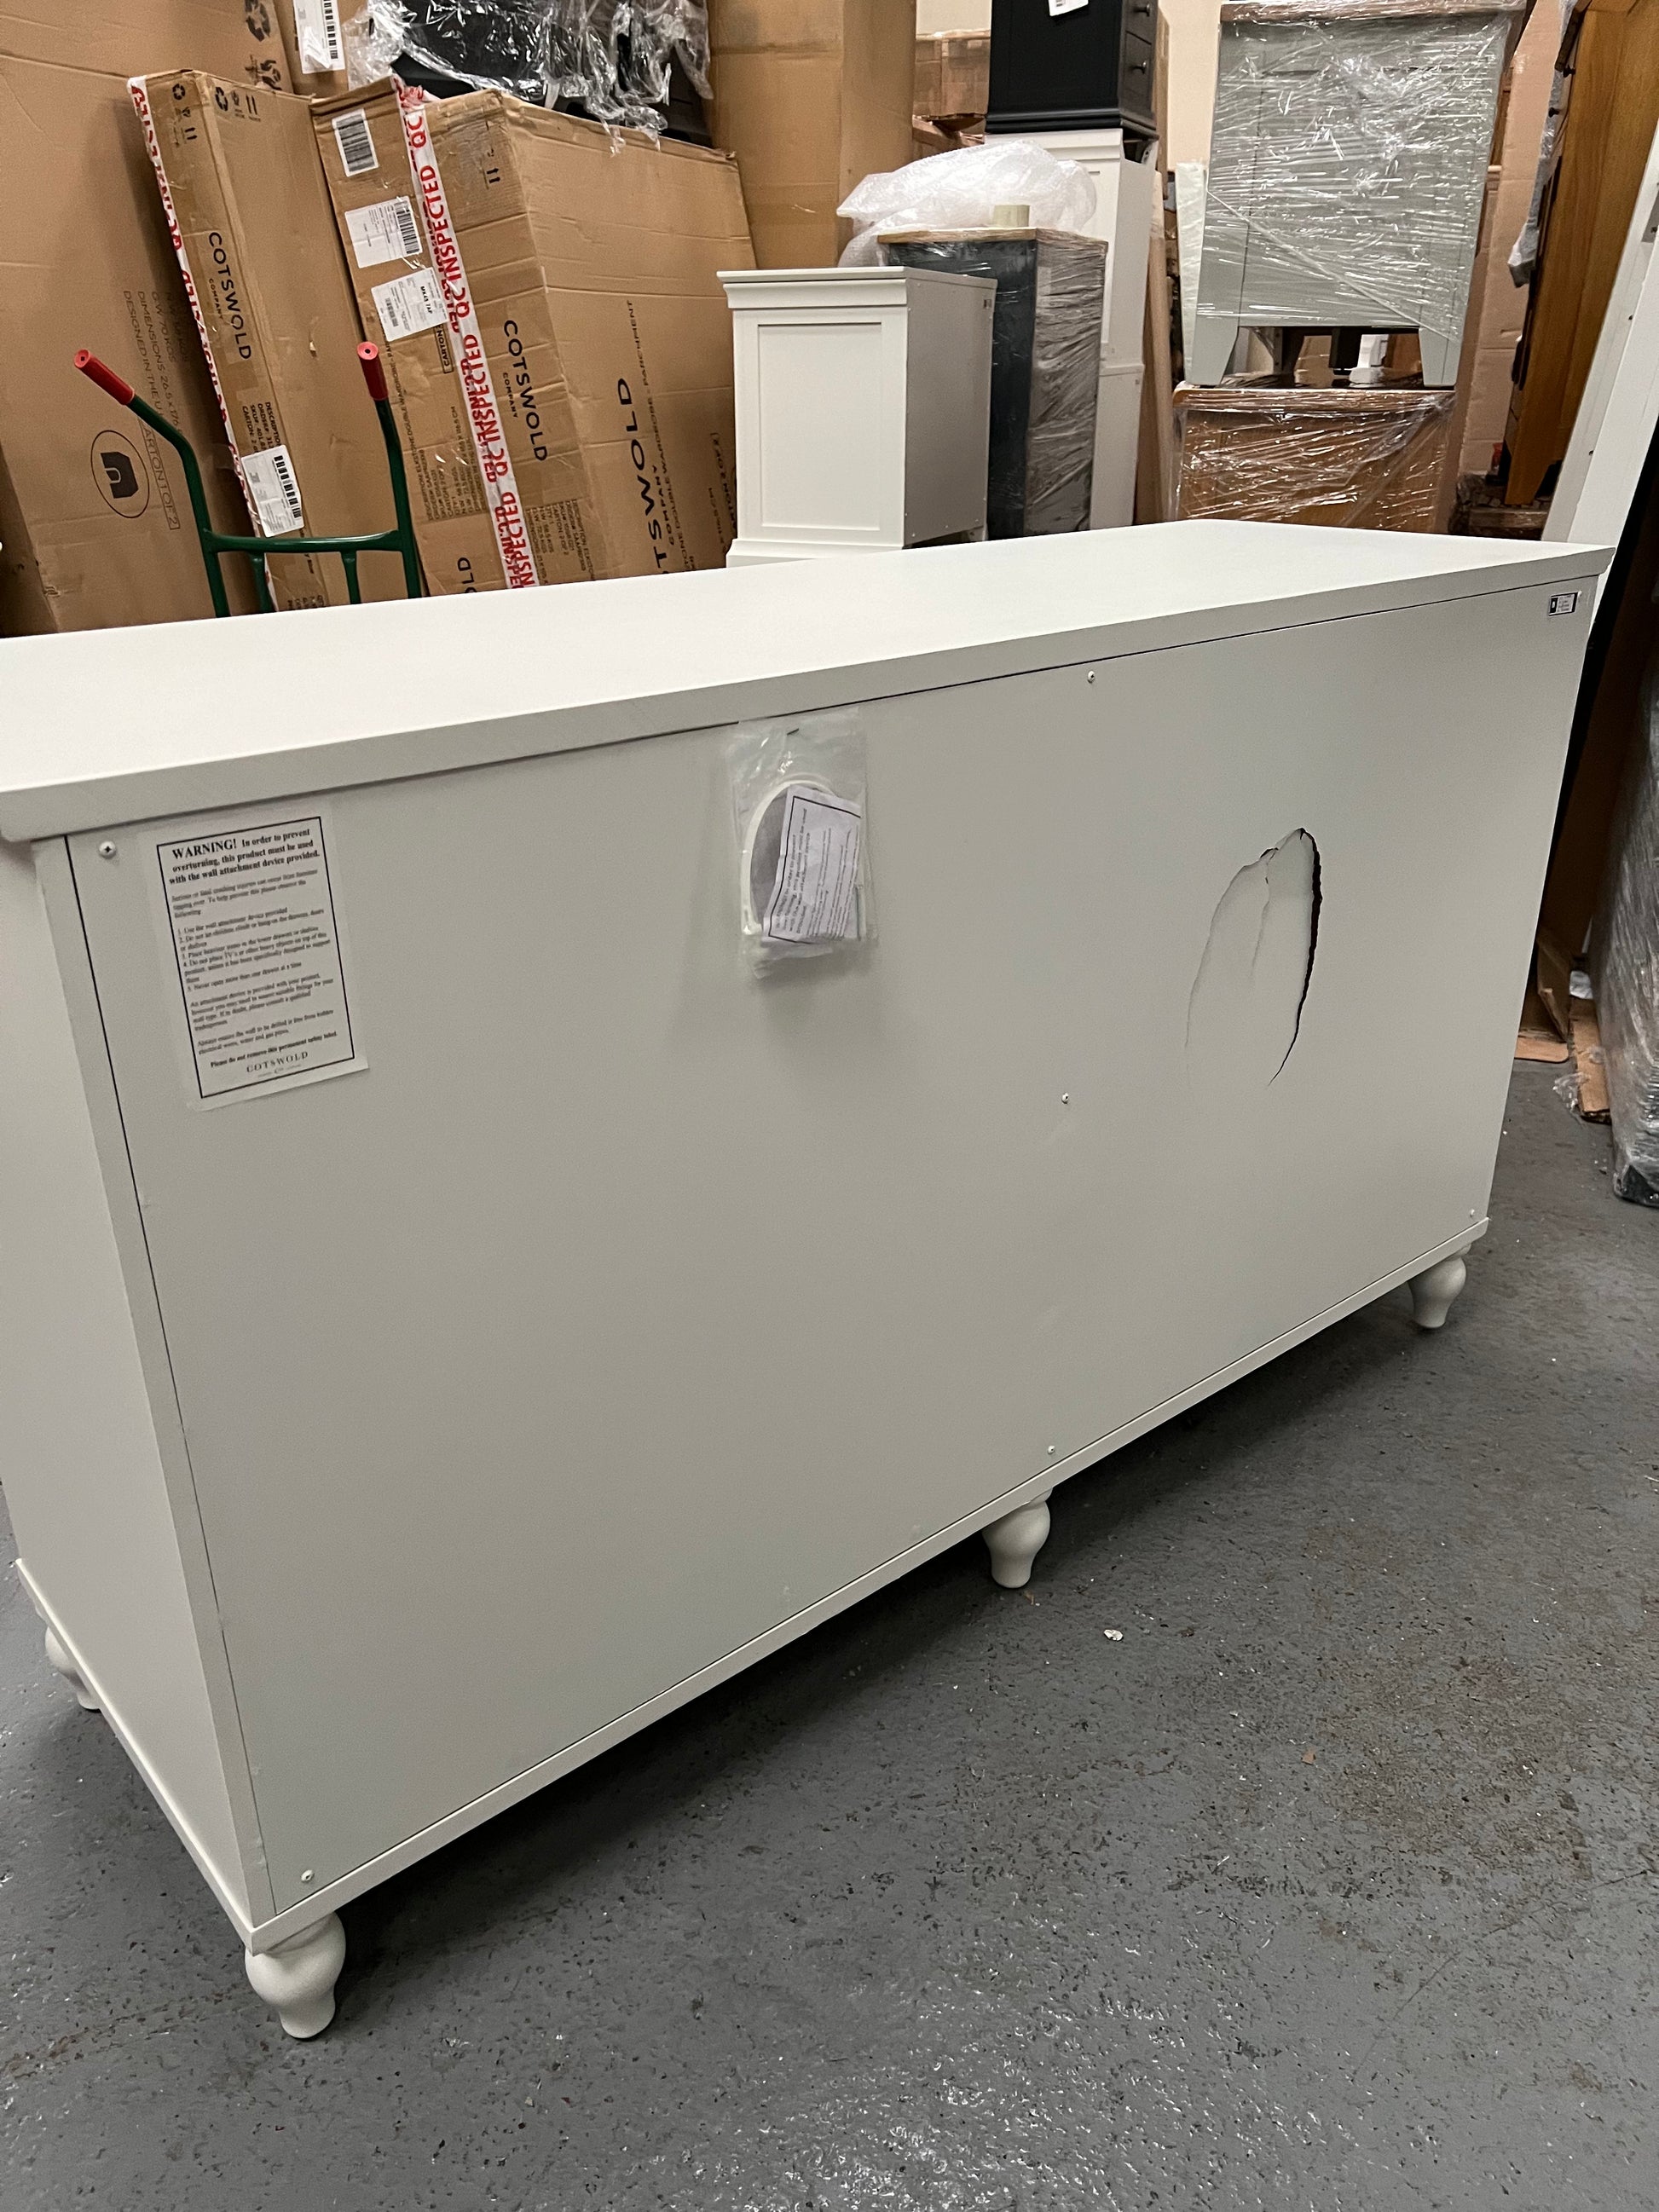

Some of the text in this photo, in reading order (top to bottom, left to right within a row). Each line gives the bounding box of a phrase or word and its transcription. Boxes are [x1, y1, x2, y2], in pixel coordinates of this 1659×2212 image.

[407, 117, 427, 149] QC
[419, 165, 462, 281] INSPECTED
[208, 232, 251, 360] COTSWOLD
[208, 278, 223, 320] COMPANY
[453, 289, 471, 318] QC
[123, 291, 147, 356] DESIGNED
[142, 358, 151, 371] IN
[147, 376, 159, 399] THE
[433, 330, 449, 367] CARTON
[627, 300, 649, 386] PARCHMENT
[463, 334, 508, 476] QC INSPECTED
[502, 372, 518, 418] COMPANY
[503, 320, 548, 461] COTSWOLD
[617, 378, 668, 574] TSWOLD
[162, 492, 174, 511] OF
[652, 465, 674, 546] COMPANY
[664, 476, 680, 529] DOUBLE
[169, 875, 186, 884] with
[201, 869, 217, 877] wall
[219, 861, 261, 875] attachment
[262, 858, 285, 867] device
[286, 850, 320, 863] provided.
[172, 838, 237, 859] WARNING!
[251, 835, 272, 845] order
[282, 829, 310, 841] prevent
[172, 858, 220, 873] overturning,
[222, 854, 235, 863] this
[236, 849, 266, 862] product
[268, 846, 286, 855] must
[298, 840, 314, 849] used
[246, 1051, 309, 1073] COTSWOLD
